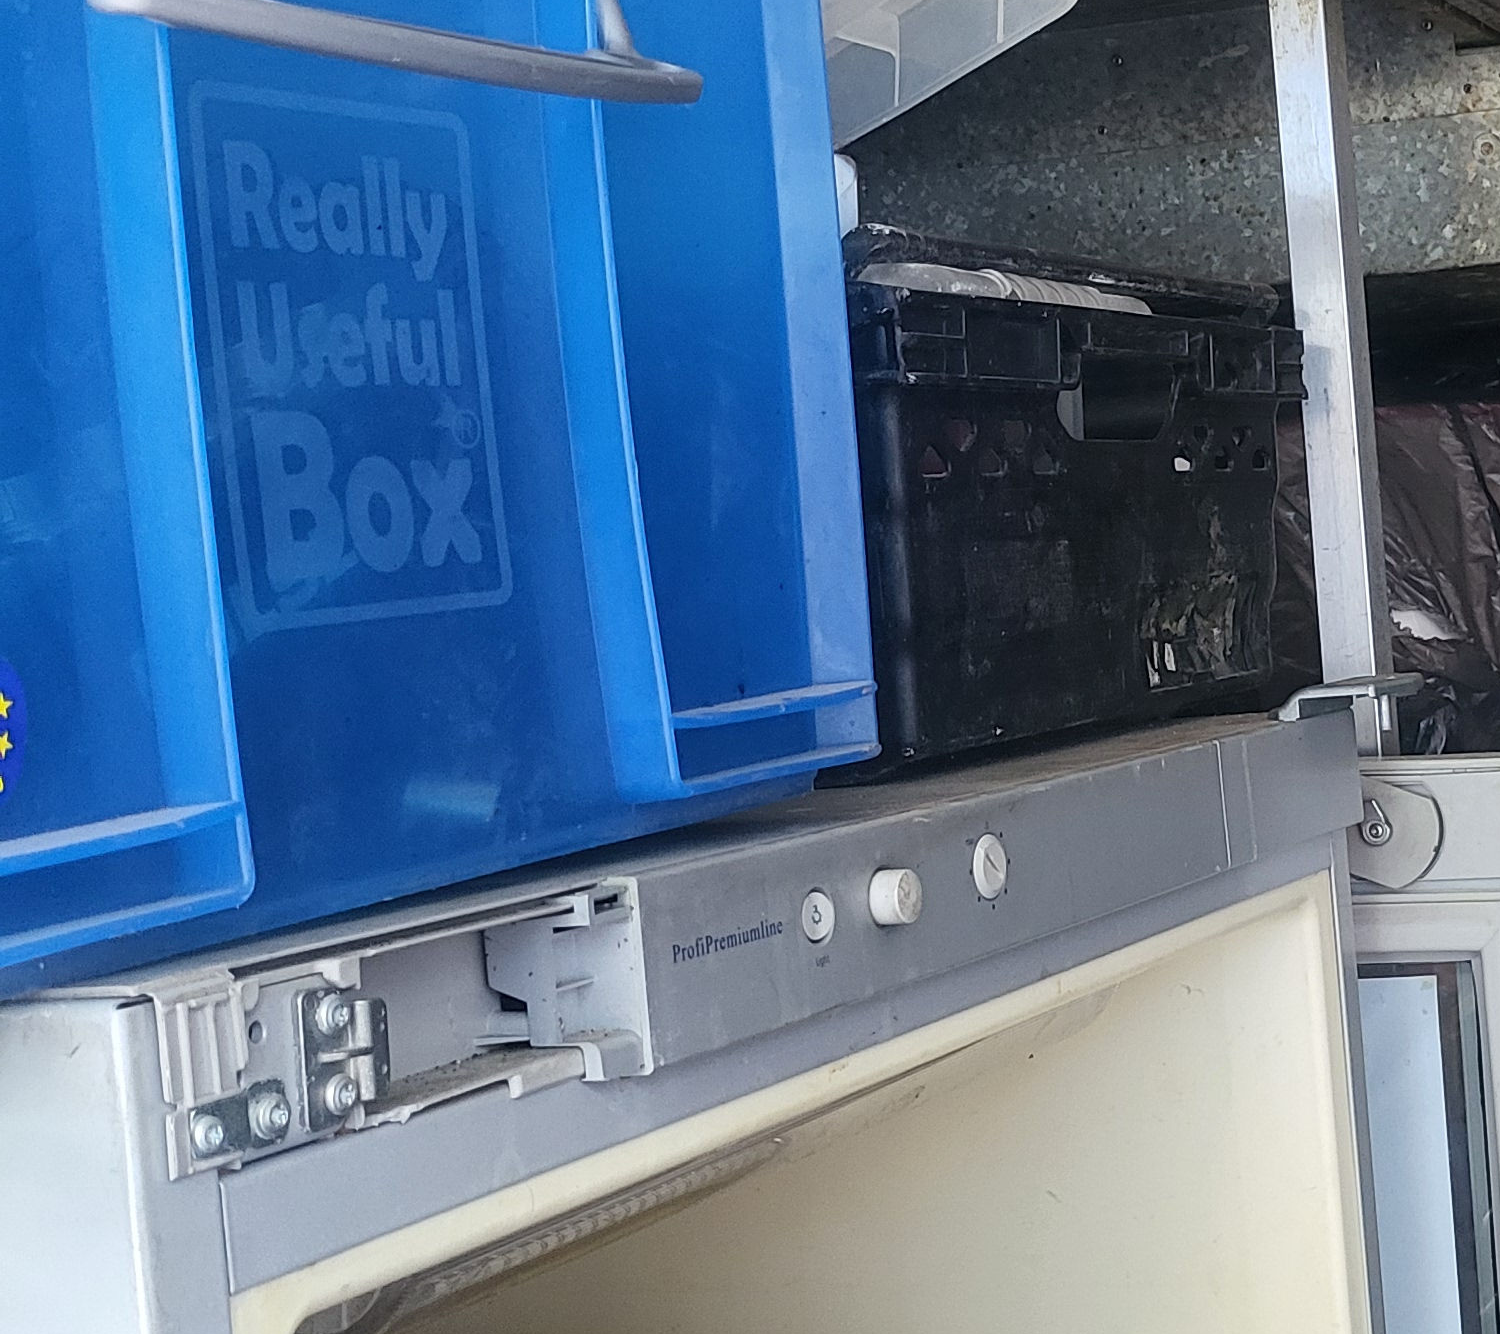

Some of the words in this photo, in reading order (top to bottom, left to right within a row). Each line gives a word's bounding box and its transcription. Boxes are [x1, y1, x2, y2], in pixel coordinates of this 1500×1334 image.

[222, 139, 447, 282] Really
[236, 280, 462, 398] Useful
[250, 409, 483, 593] Box
[672, 918, 784, 964] ProfiPremiumline
